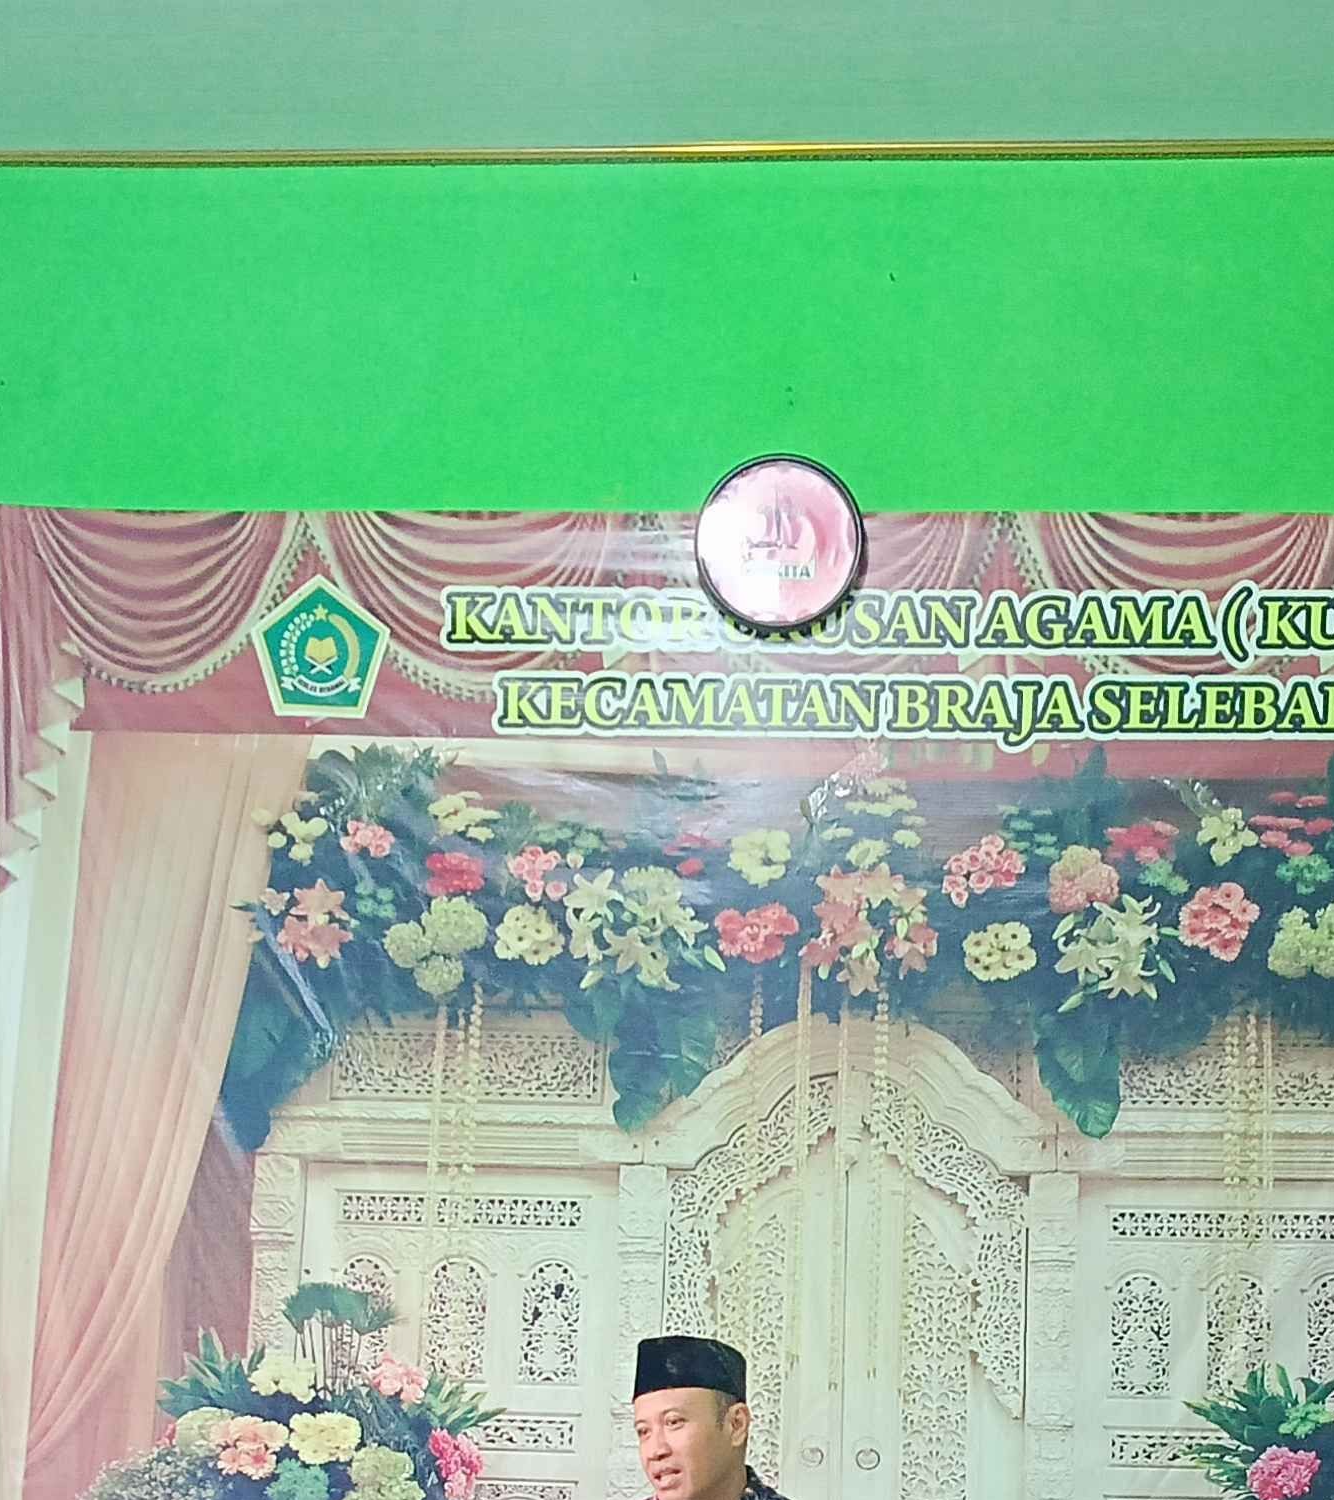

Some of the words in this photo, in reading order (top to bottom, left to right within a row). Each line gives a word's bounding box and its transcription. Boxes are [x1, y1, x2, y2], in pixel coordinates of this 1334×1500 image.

[445, 590, 709, 647] KANTOR
[977, 594, 1215, 650] AGAMA
[499, 676, 880, 732] KECAMATAN
[889, 679, 1084, 747] BRAJA
